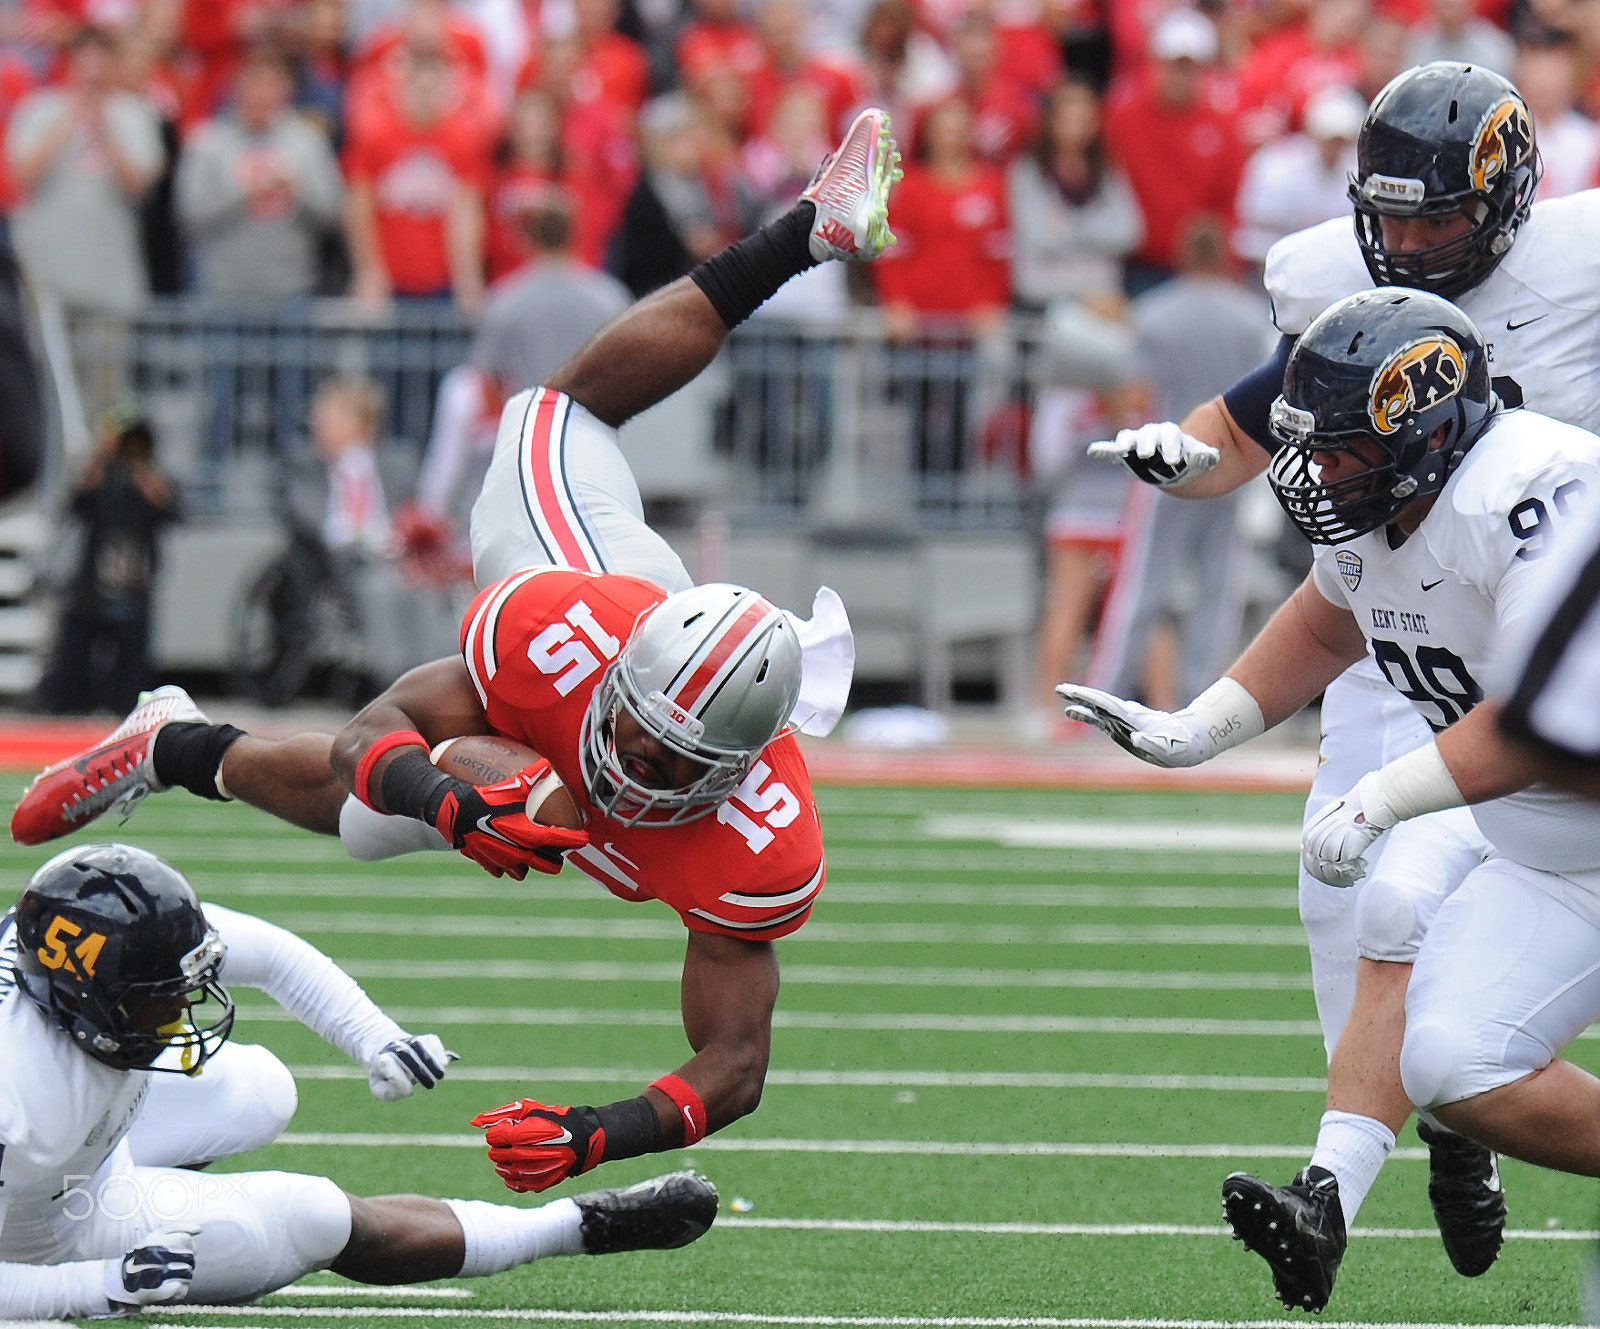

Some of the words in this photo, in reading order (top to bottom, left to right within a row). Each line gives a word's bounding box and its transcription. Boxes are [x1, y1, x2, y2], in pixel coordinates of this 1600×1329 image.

[526, 599, 621, 698] 15
[1371, 608, 1397, 630] KENT
[1400, 612, 1430, 635] STATE
[1208, 714, 1242, 746] Pads
[716, 758, 801, 855] 15
[37, 915, 108, 982] 54
